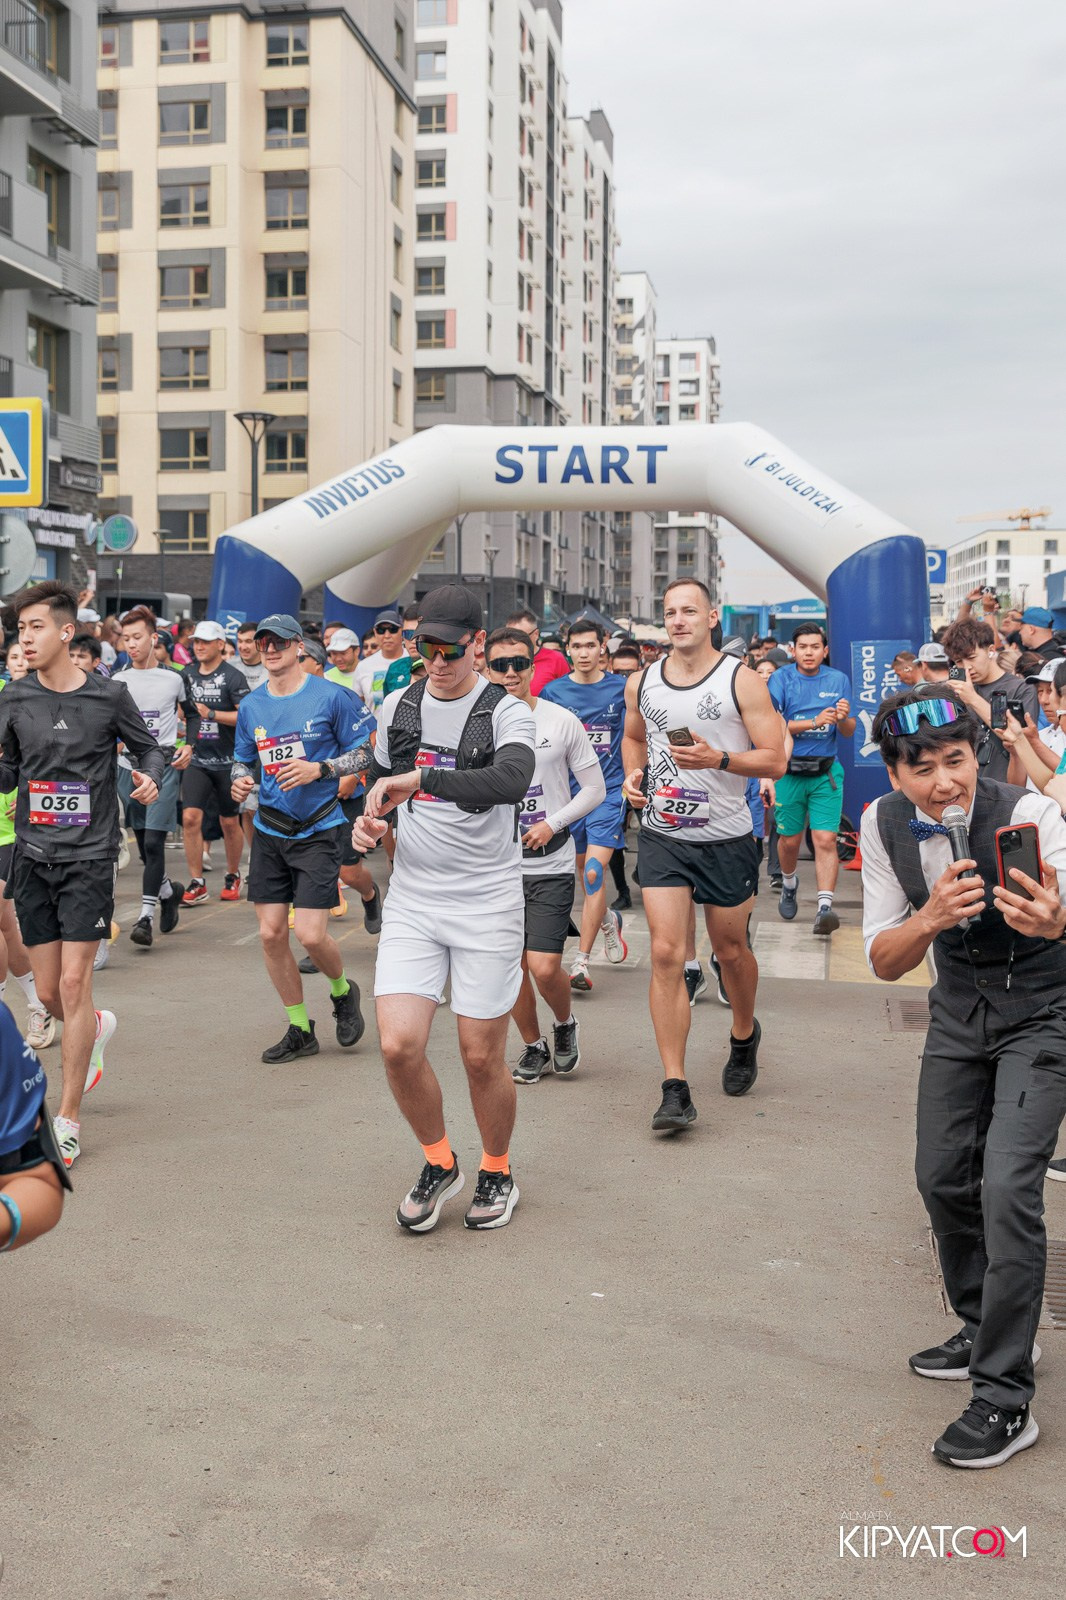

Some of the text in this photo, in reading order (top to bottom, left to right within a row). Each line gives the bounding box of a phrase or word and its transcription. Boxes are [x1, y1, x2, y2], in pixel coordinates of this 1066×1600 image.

[495, 444, 668, 484] START
[765, 461, 785, 476] BI
[304, 459, 405, 519] INVICTUS
[860, 646, 876, 703] Arena
[881, 663, 899, 701] City
[269, 746, 294, 762] 182
[41, 796, 79, 811] 036
[662, 800, 699, 815] 287
